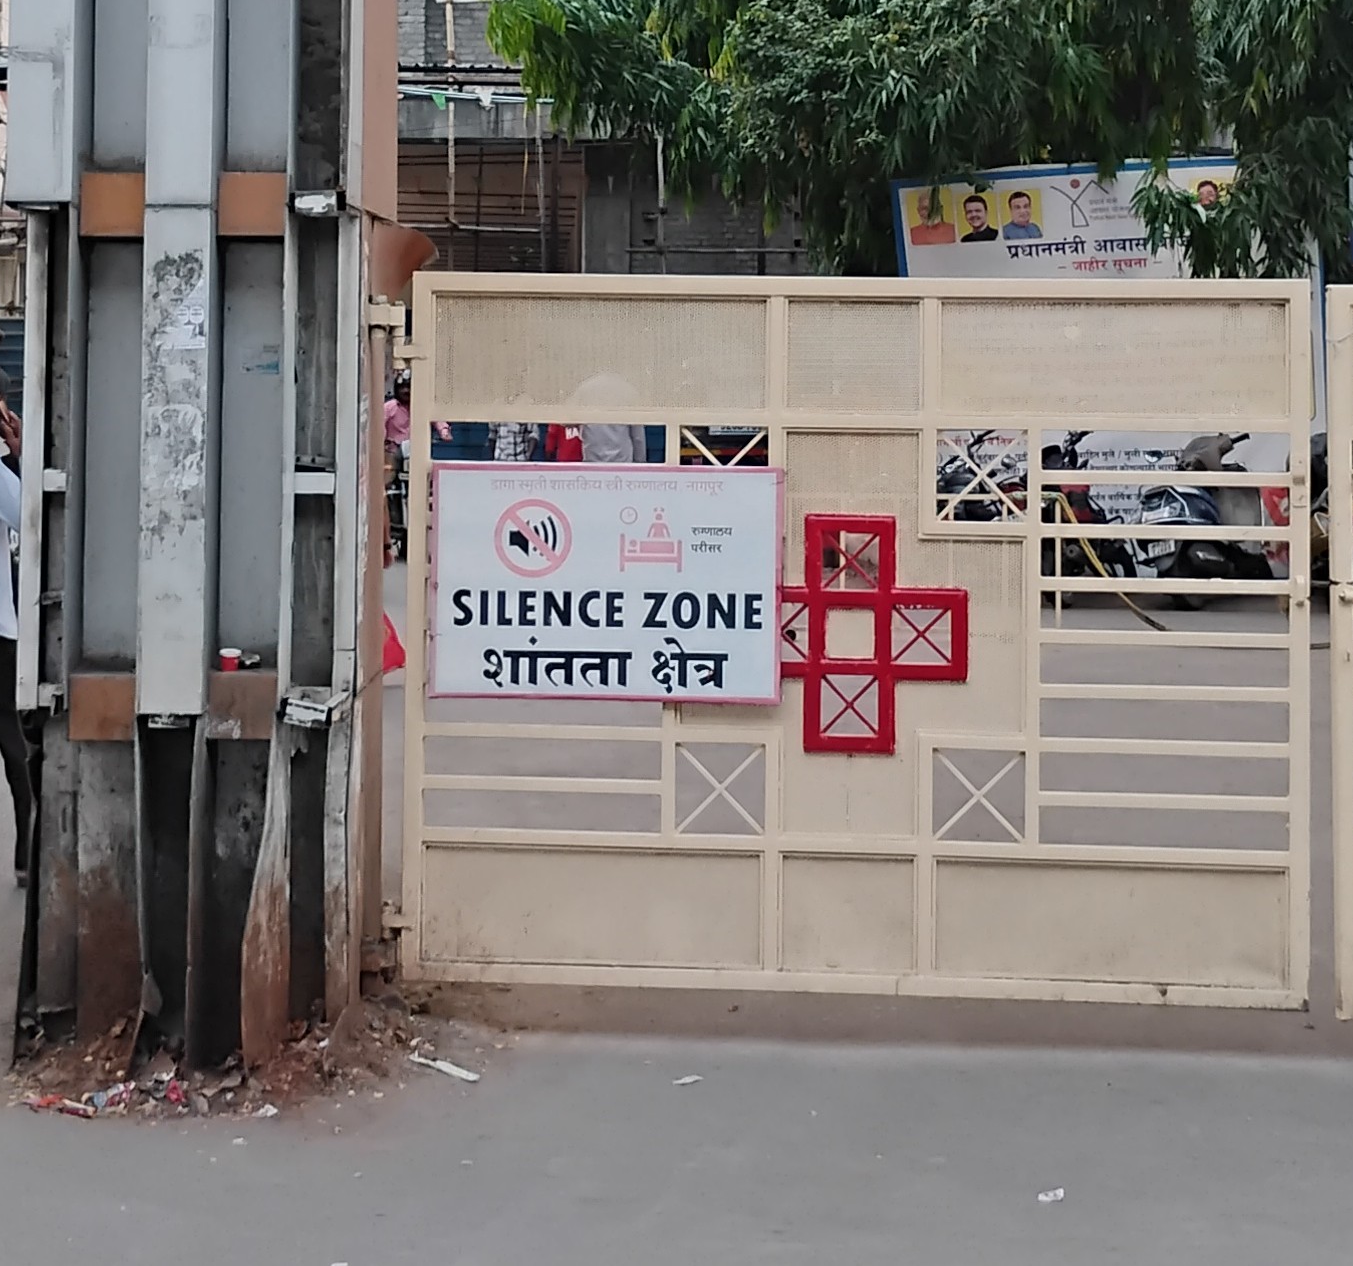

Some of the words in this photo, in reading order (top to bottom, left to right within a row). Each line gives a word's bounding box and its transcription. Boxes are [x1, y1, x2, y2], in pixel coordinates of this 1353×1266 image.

[1006, 235, 1086, 260] प्रधानमंत्री
[1094, 237, 1148, 254] आवास
[1072, 256, 1108, 273] जाहीर
[1112, 257, 1148, 275] सूचना
[490, 477, 516, 491] डागा
[690, 540, 723, 554] परीसर
[452, 589, 625, 628] SILENCE
[642, 591, 764, 630] ZONE
[482, 636, 633, 689] शांतता
[650, 636, 729, 694] क्षेत्र
